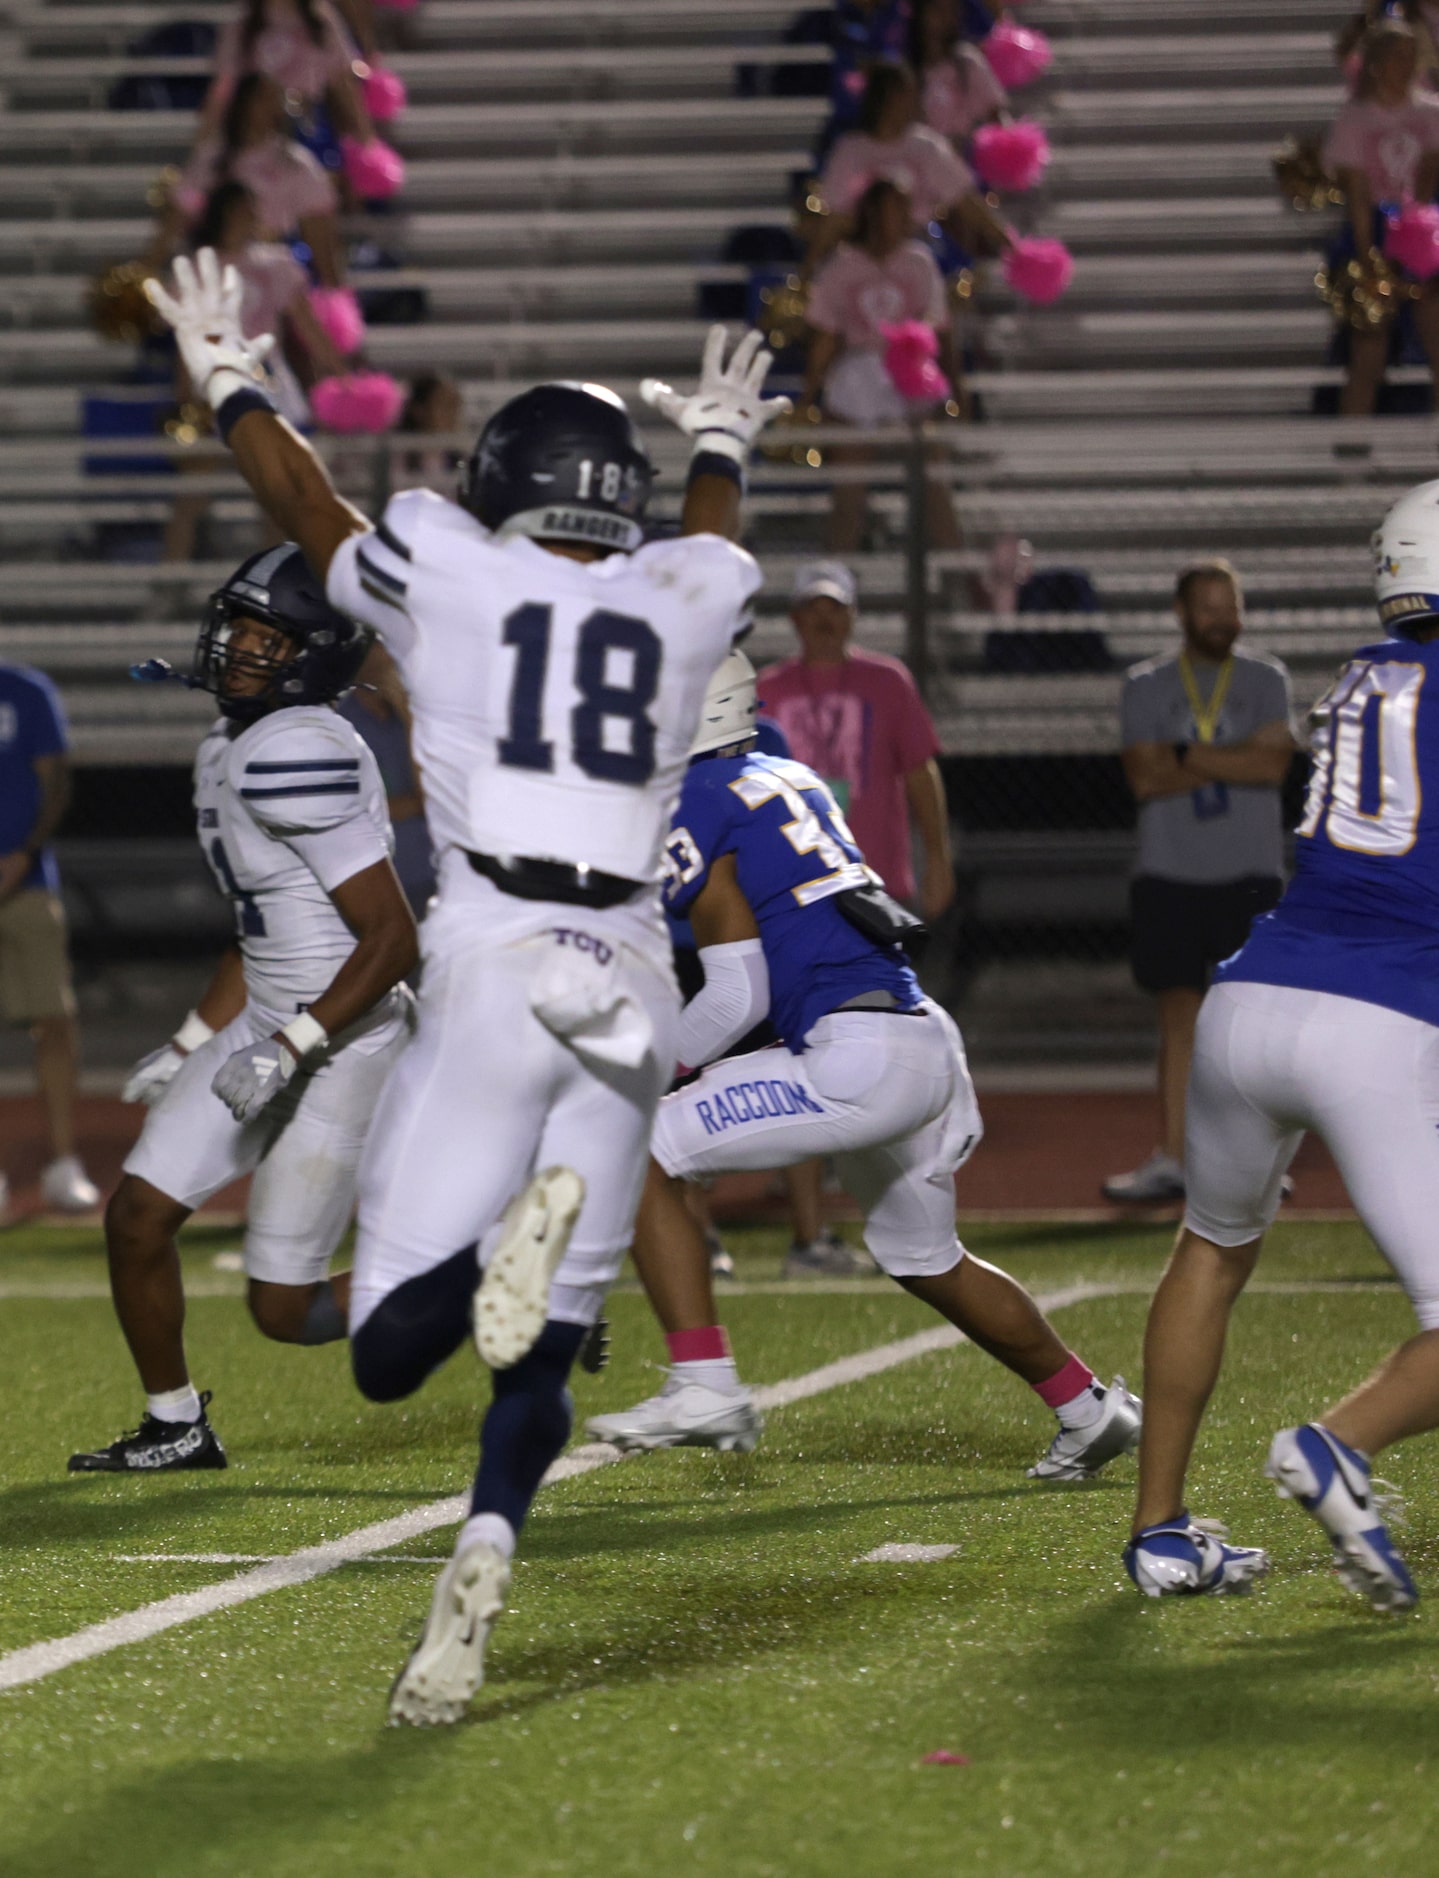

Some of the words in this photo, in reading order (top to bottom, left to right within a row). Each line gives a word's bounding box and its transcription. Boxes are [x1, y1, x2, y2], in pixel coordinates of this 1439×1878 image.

[576, 460, 622, 502] 18
[542, 511, 631, 545] RANGERS
[496, 599, 664, 788] 18
[1295, 660, 1426, 856] 0
[551, 926, 614, 967] TCU
[695, 1079, 825, 1135] RACCOON
